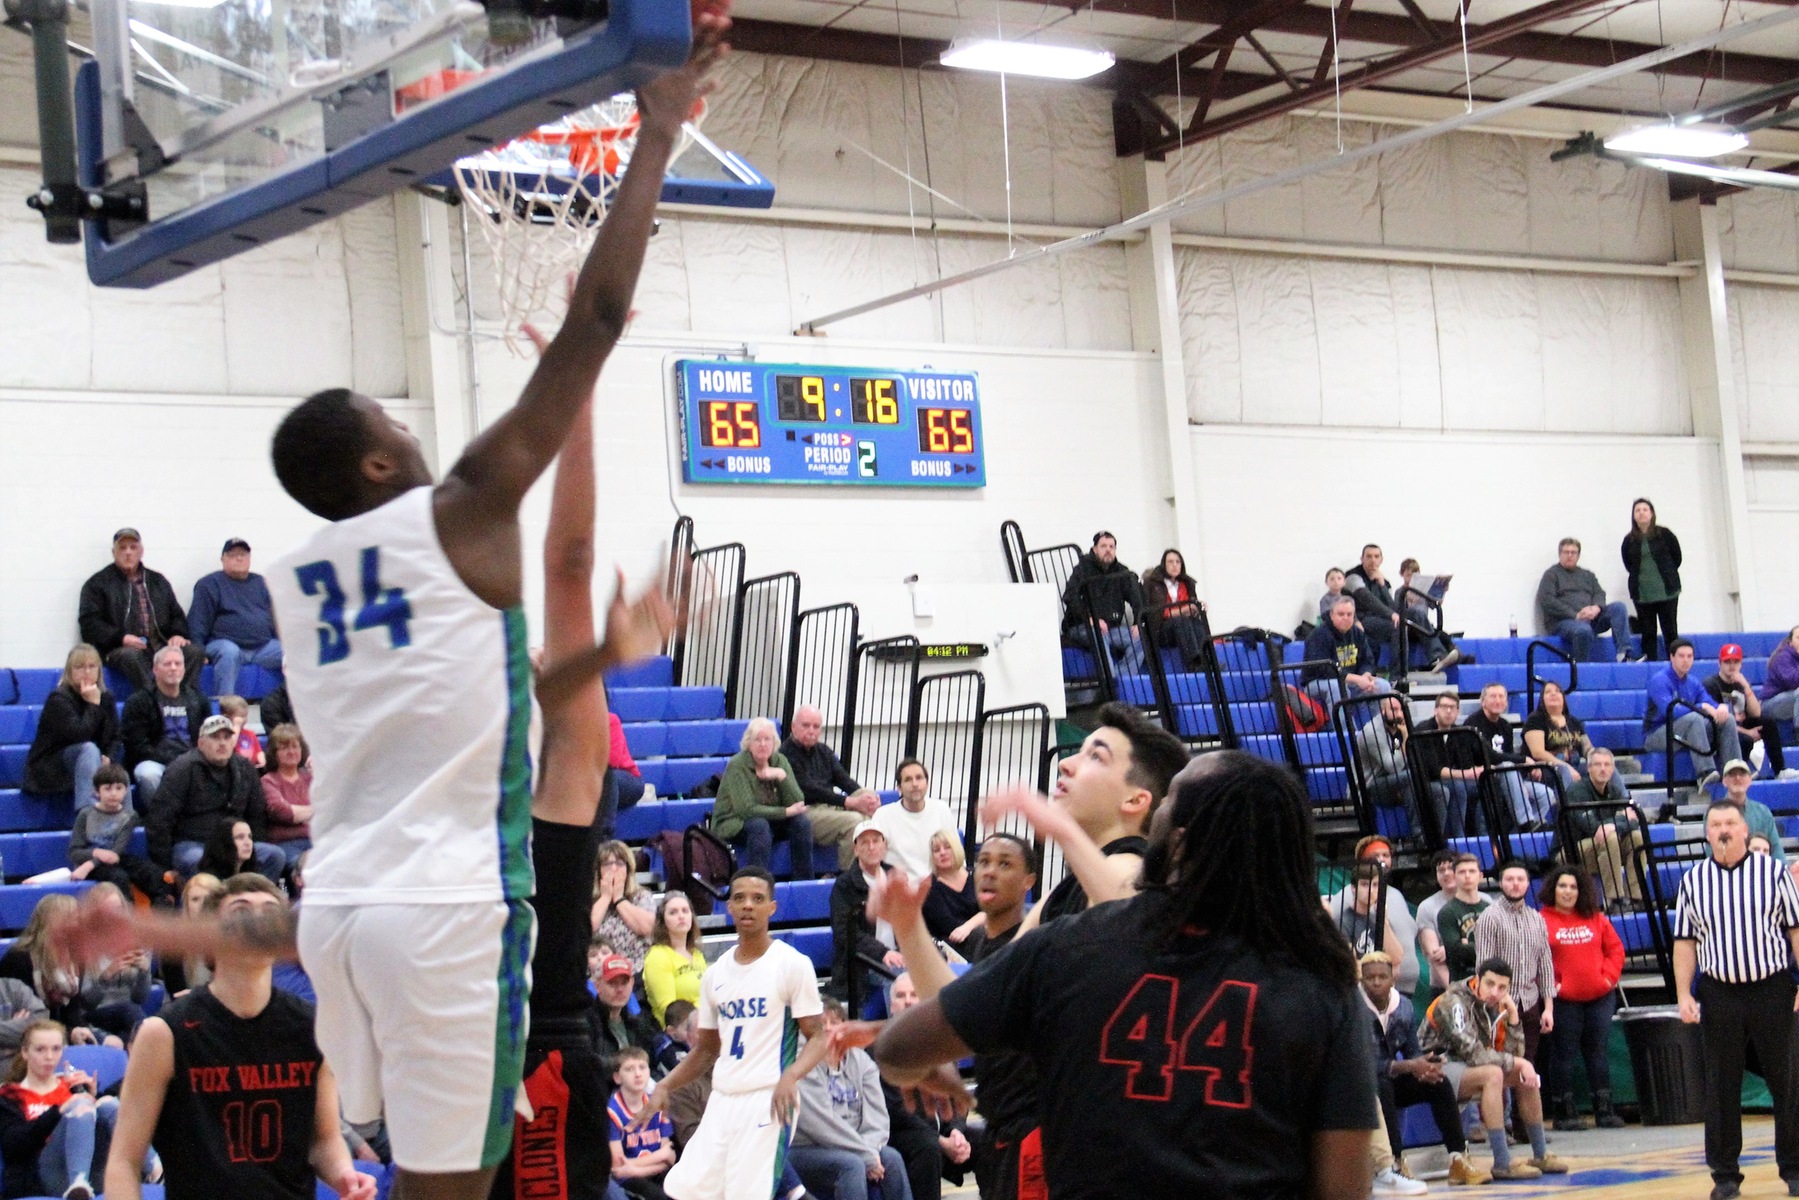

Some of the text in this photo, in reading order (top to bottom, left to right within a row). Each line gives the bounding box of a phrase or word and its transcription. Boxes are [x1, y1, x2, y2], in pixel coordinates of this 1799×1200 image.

[699, 369, 753, 393] HOME
[908, 378, 974, 401] VISITOR
[709, 401, 760, 447] 65
[814, 432, 840, 447] POSS
[926, 408, 974, 453] 65
[727, 455, 772, 474] BONUS
[804, 446, 852, 464] PERIOD
[858, 441, 876, 477] 2
[911, 460, 952, 478] BONUS
[293, 545, 413, 666] 34
[956, 645, 969, 656] PM
[729, 1025, 745, 1060] 4
[1099, 973, 1259, 1109] 44
[189, 1061, 316, 1093] FOX VALLEY
[223, 1099, 284, 1163] 10
